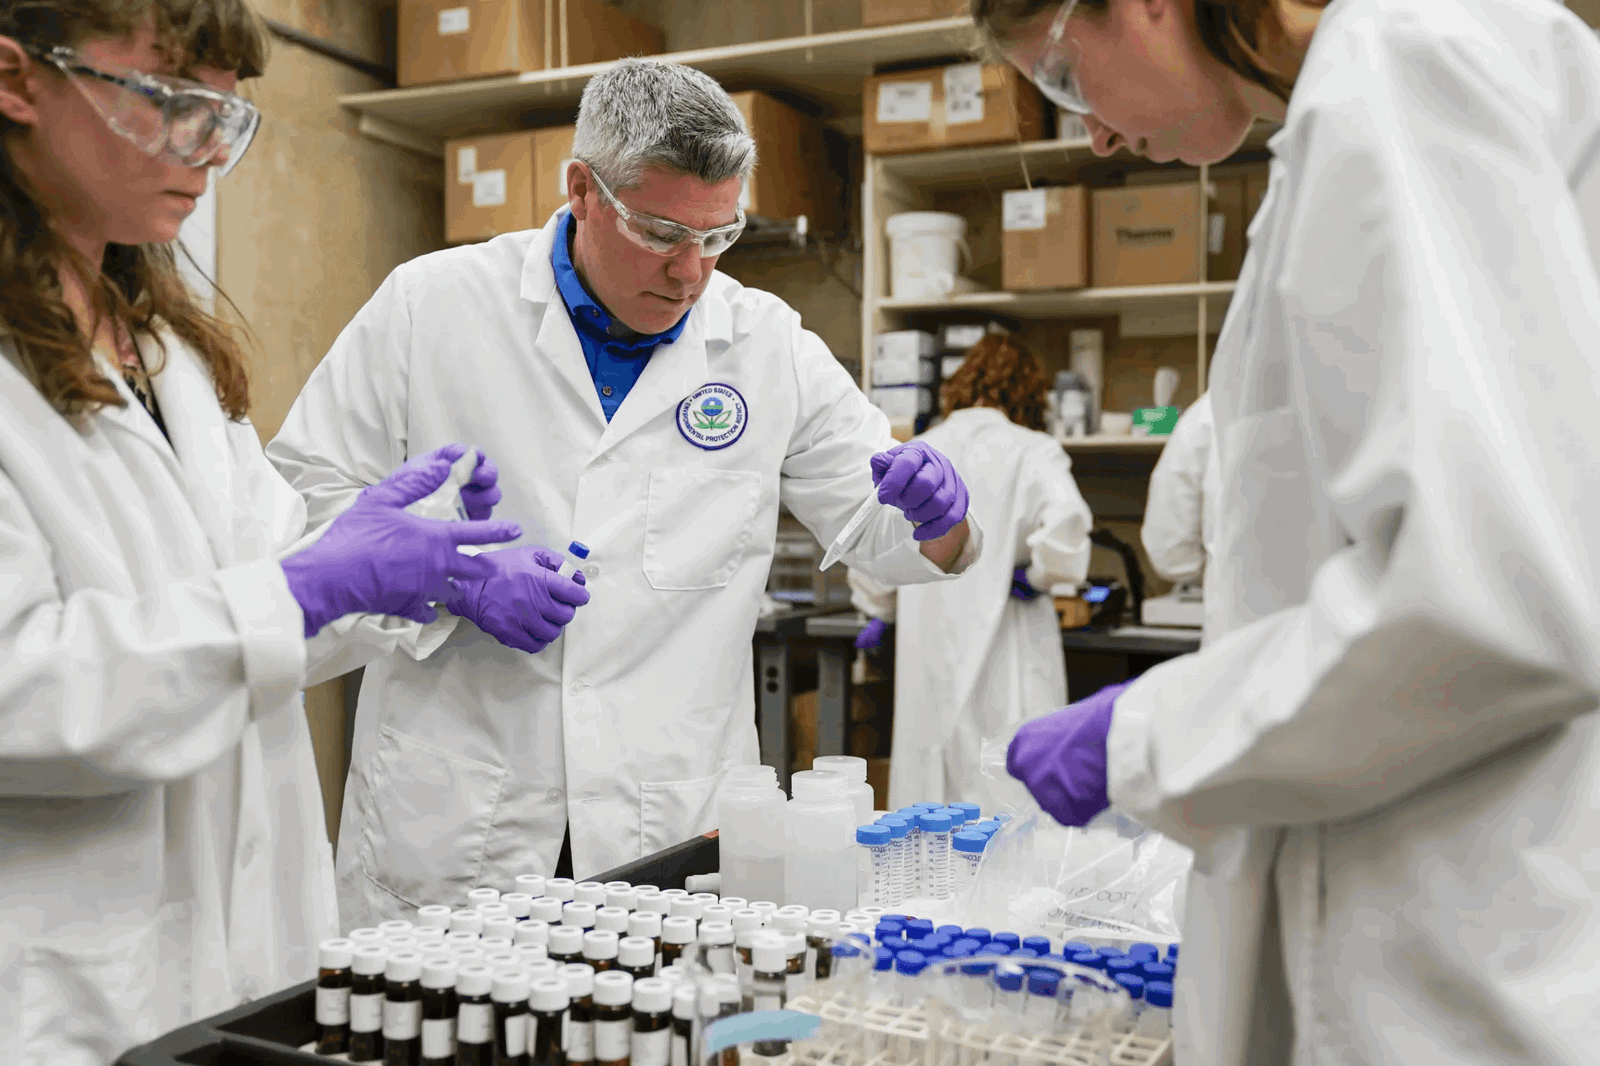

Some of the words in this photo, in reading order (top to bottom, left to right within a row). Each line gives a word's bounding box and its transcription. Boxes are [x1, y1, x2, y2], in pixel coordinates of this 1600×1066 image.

[692, 388, 712, 399] UNITED
[714, 388, 733, 398] STATES
[705, 424, 739, 442] PROTECTION
